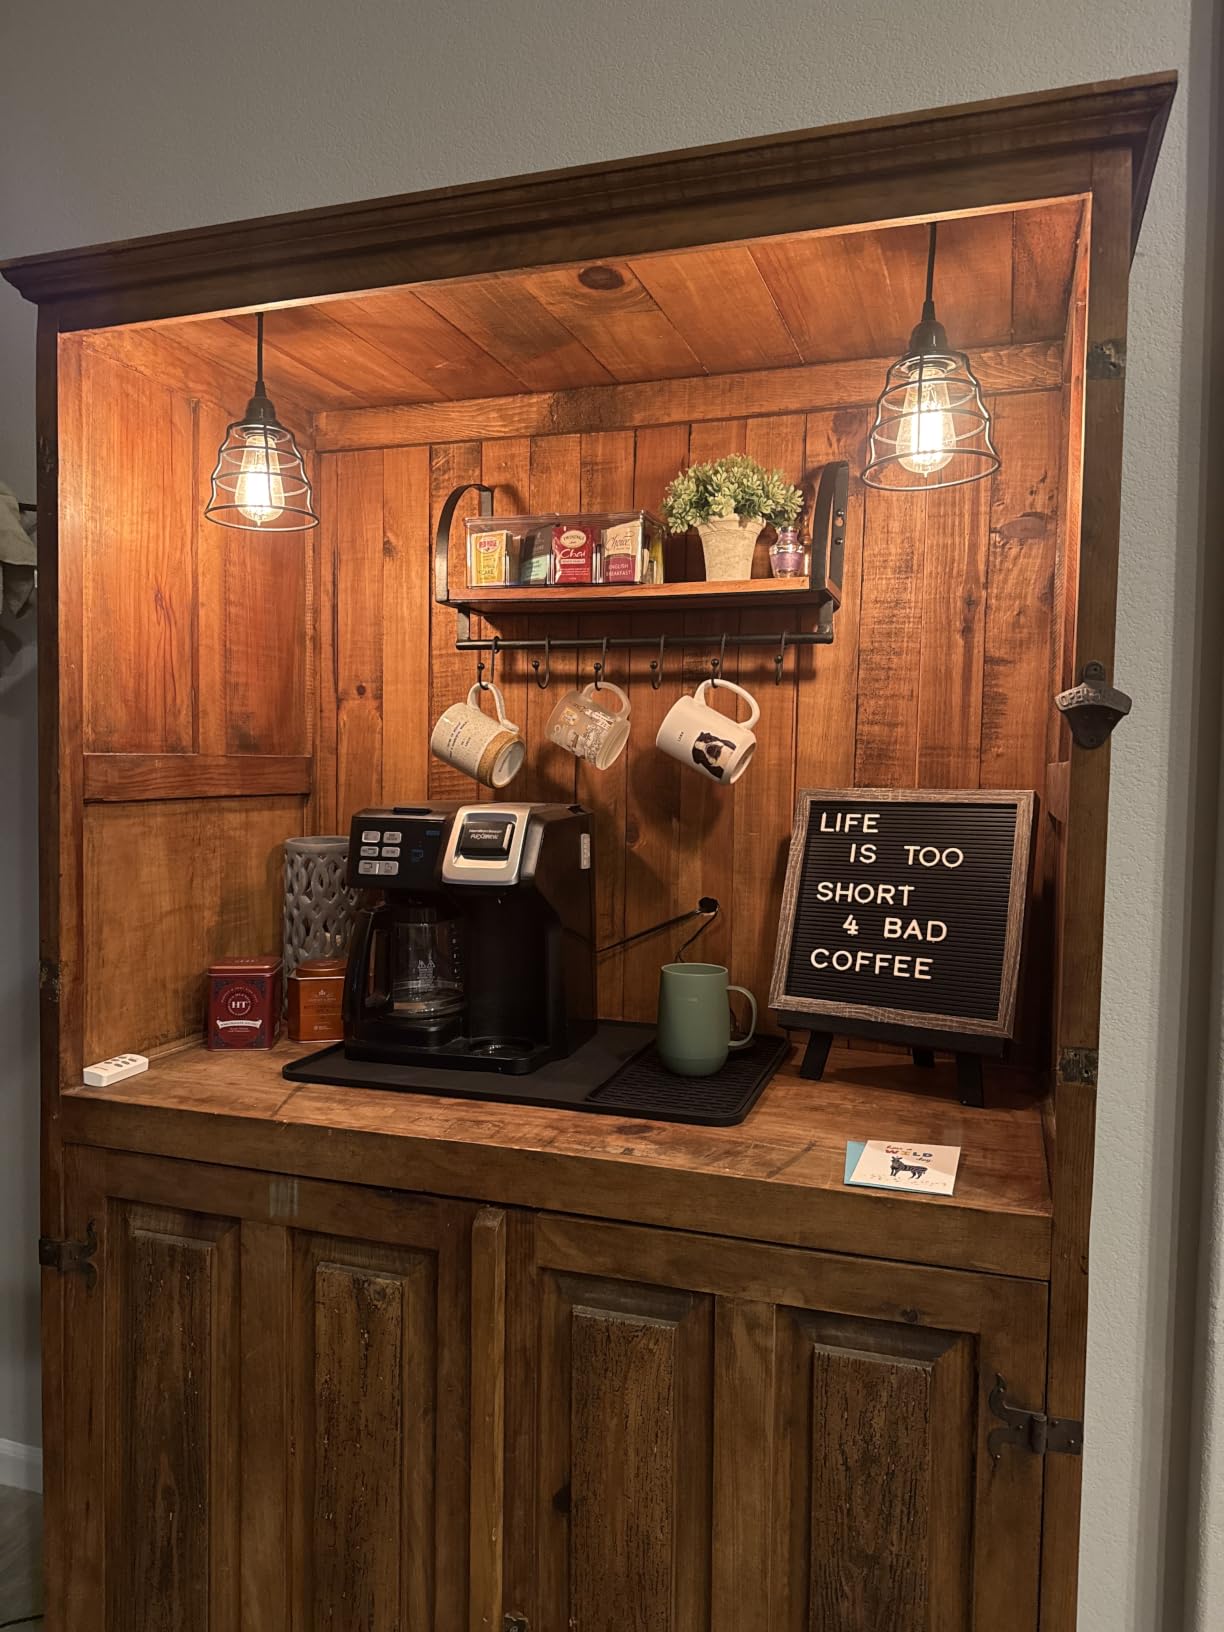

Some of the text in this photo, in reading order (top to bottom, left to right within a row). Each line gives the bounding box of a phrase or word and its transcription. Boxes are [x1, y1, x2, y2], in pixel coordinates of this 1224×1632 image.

[558, 548, 586, 559] Chai
[819, 811, 881, 834] LIFE
[849, 843, 964, 869] IS TOO
[816, 881, 916, 907] SHORT
[842, 914, 948, 943] 4 BAD
[809, 947, 934, 981] COFFEE
